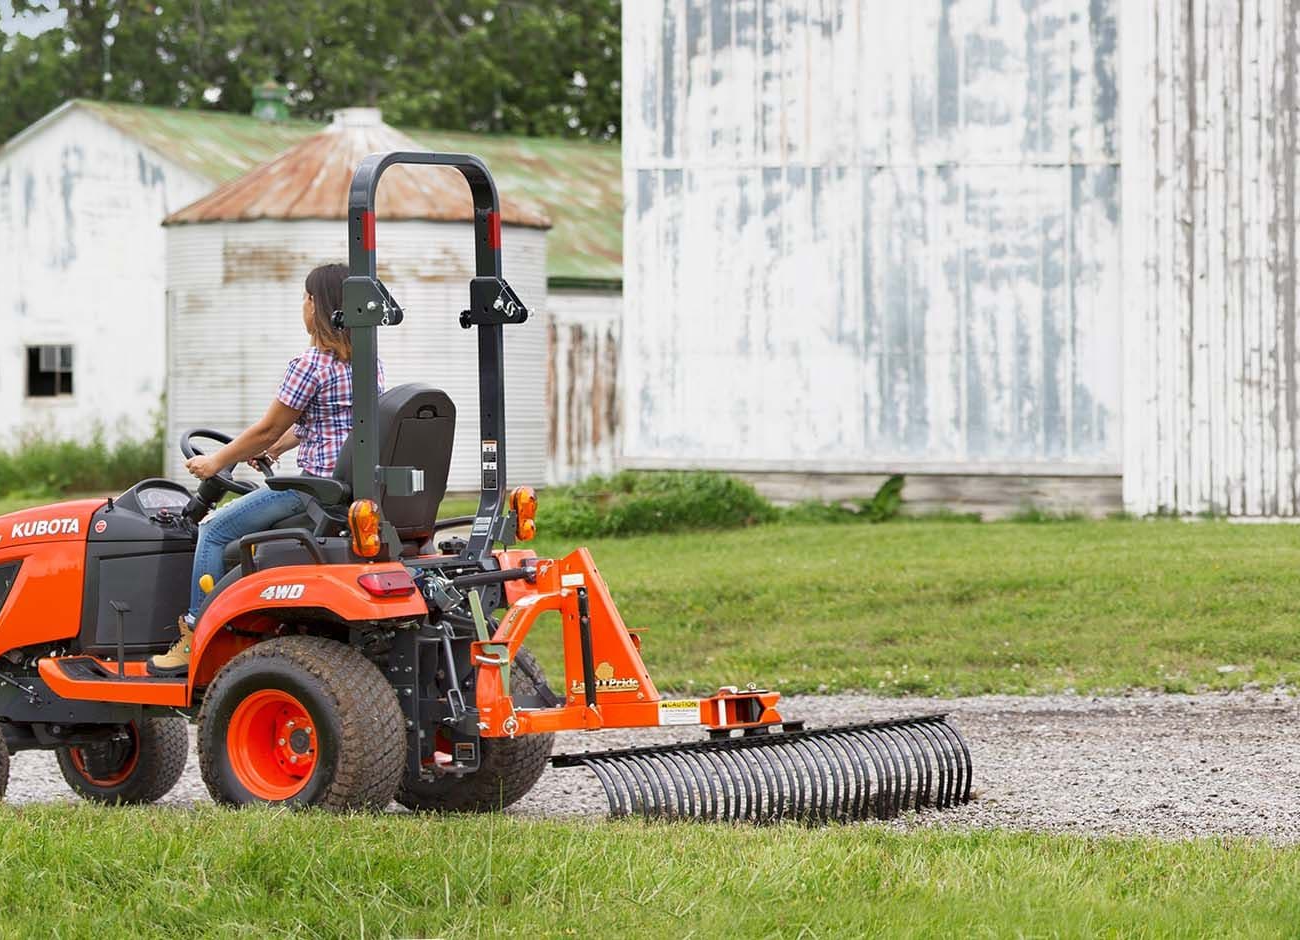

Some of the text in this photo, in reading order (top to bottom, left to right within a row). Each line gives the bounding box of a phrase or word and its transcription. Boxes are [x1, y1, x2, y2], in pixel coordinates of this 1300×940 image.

[12, 518, 79, 538] KUBOTA
[260, 584, 305, 600] 4WD
[609, 677, 638, 689] Pride
